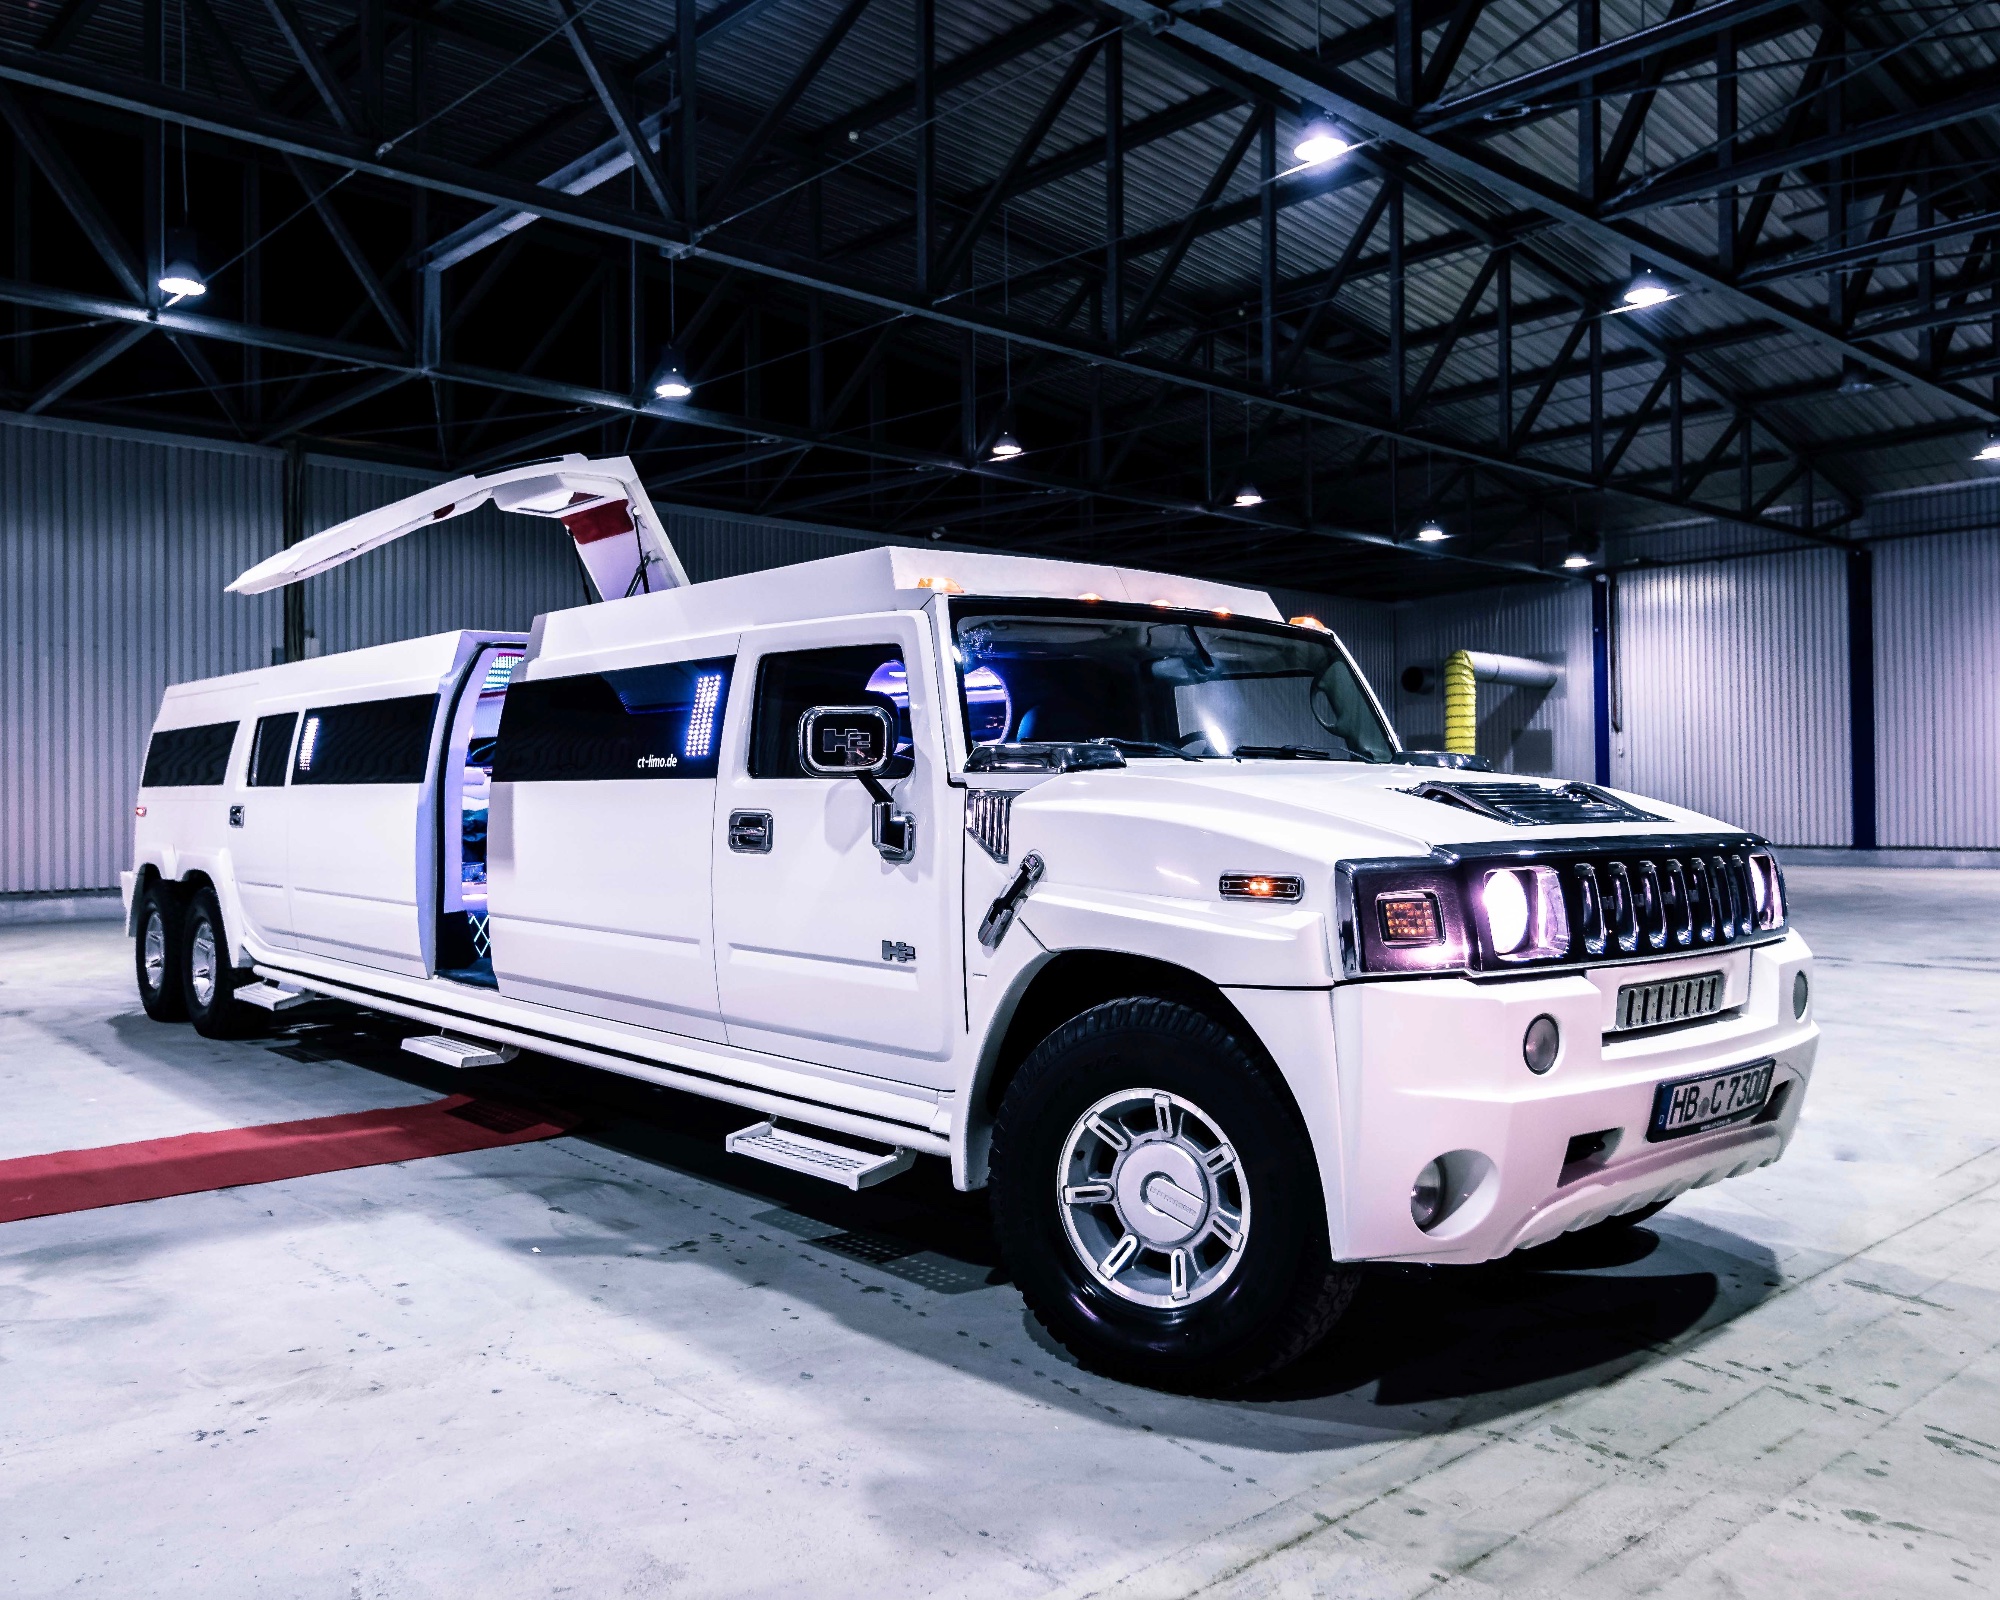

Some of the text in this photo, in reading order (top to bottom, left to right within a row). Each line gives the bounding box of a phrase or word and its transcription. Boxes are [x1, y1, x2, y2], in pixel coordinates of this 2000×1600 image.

[822, 728, 871, 753] H2
[637, 753, 678, 769] ct-limo.de
[881, 939, 916, 963] H2
[1669, 1067, 1771, 1125] HB C 7300
